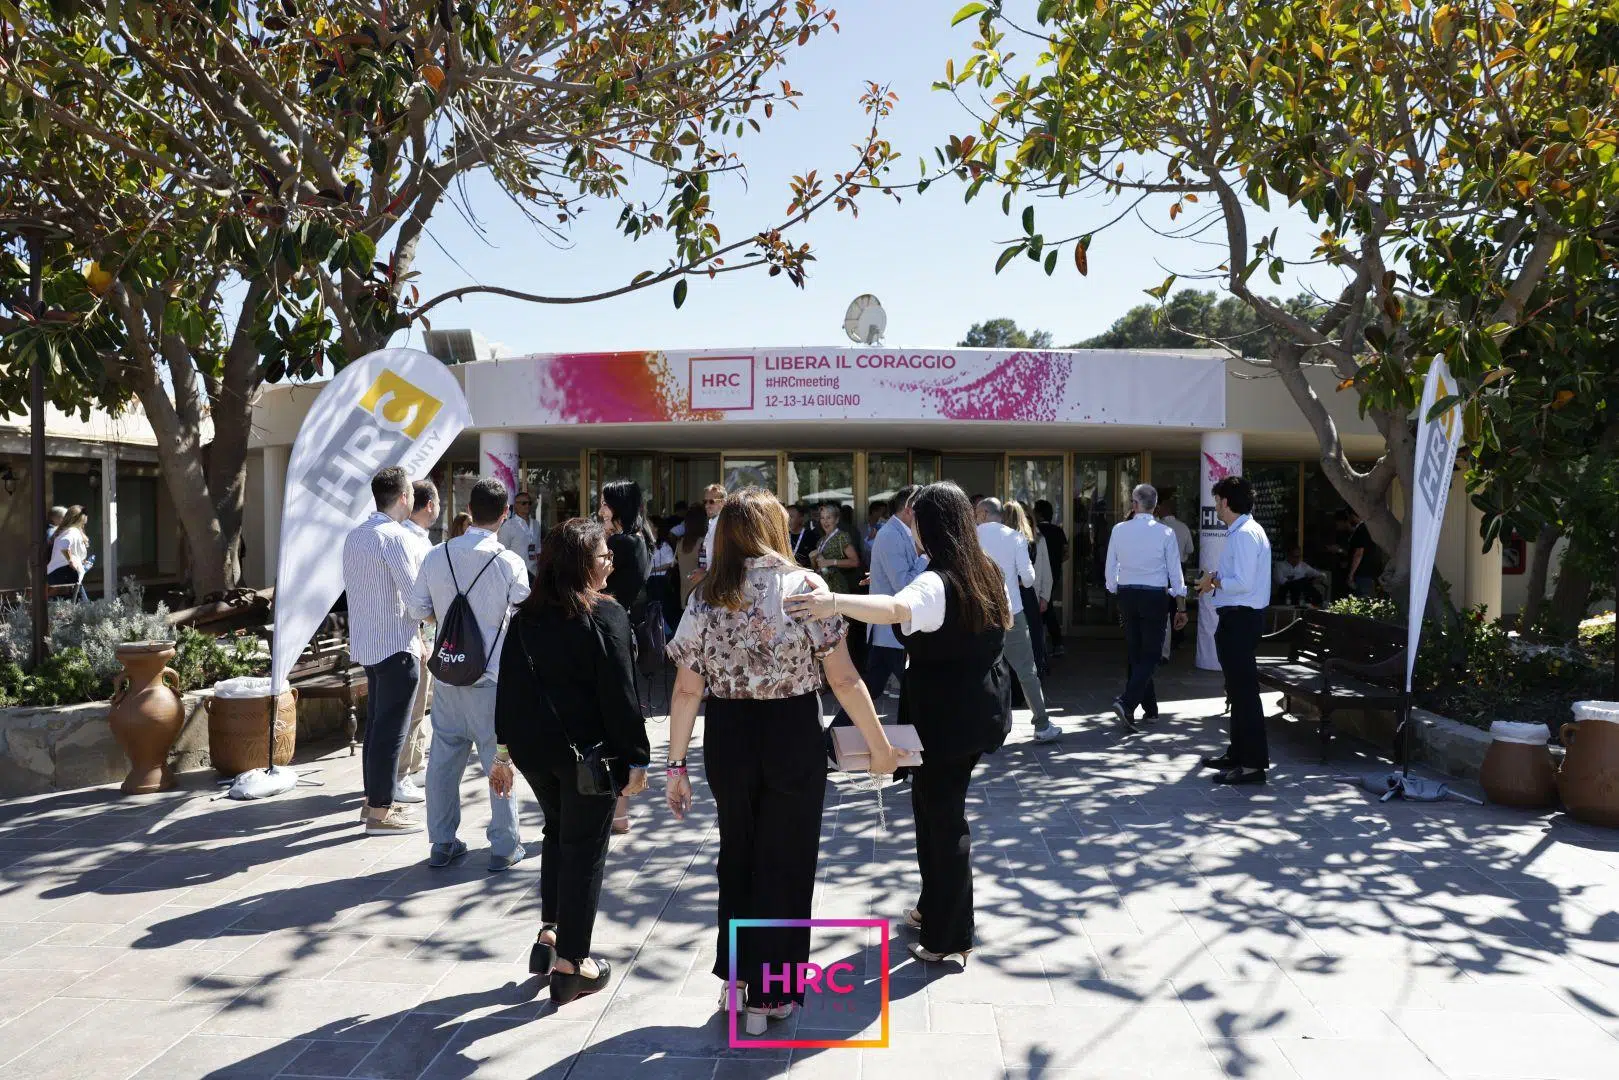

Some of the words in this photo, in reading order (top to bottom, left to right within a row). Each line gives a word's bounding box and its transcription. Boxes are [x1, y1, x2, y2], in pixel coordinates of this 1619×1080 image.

[765, 355, 831, 370] LIBERA
[836, 355, 852, 369] IL
[856, 354, 956, 369] CORAGGIO
[701, 373, 741, 387] HRC
[765, 375, 840, 389] #HRCmeeting
[765, 395, 815, 407] 12-13-14
[816, 394, 861, 406] GIUGNO
[316, 390, 419, 504] HRC
[408, 430, 442, 476] UNITY
